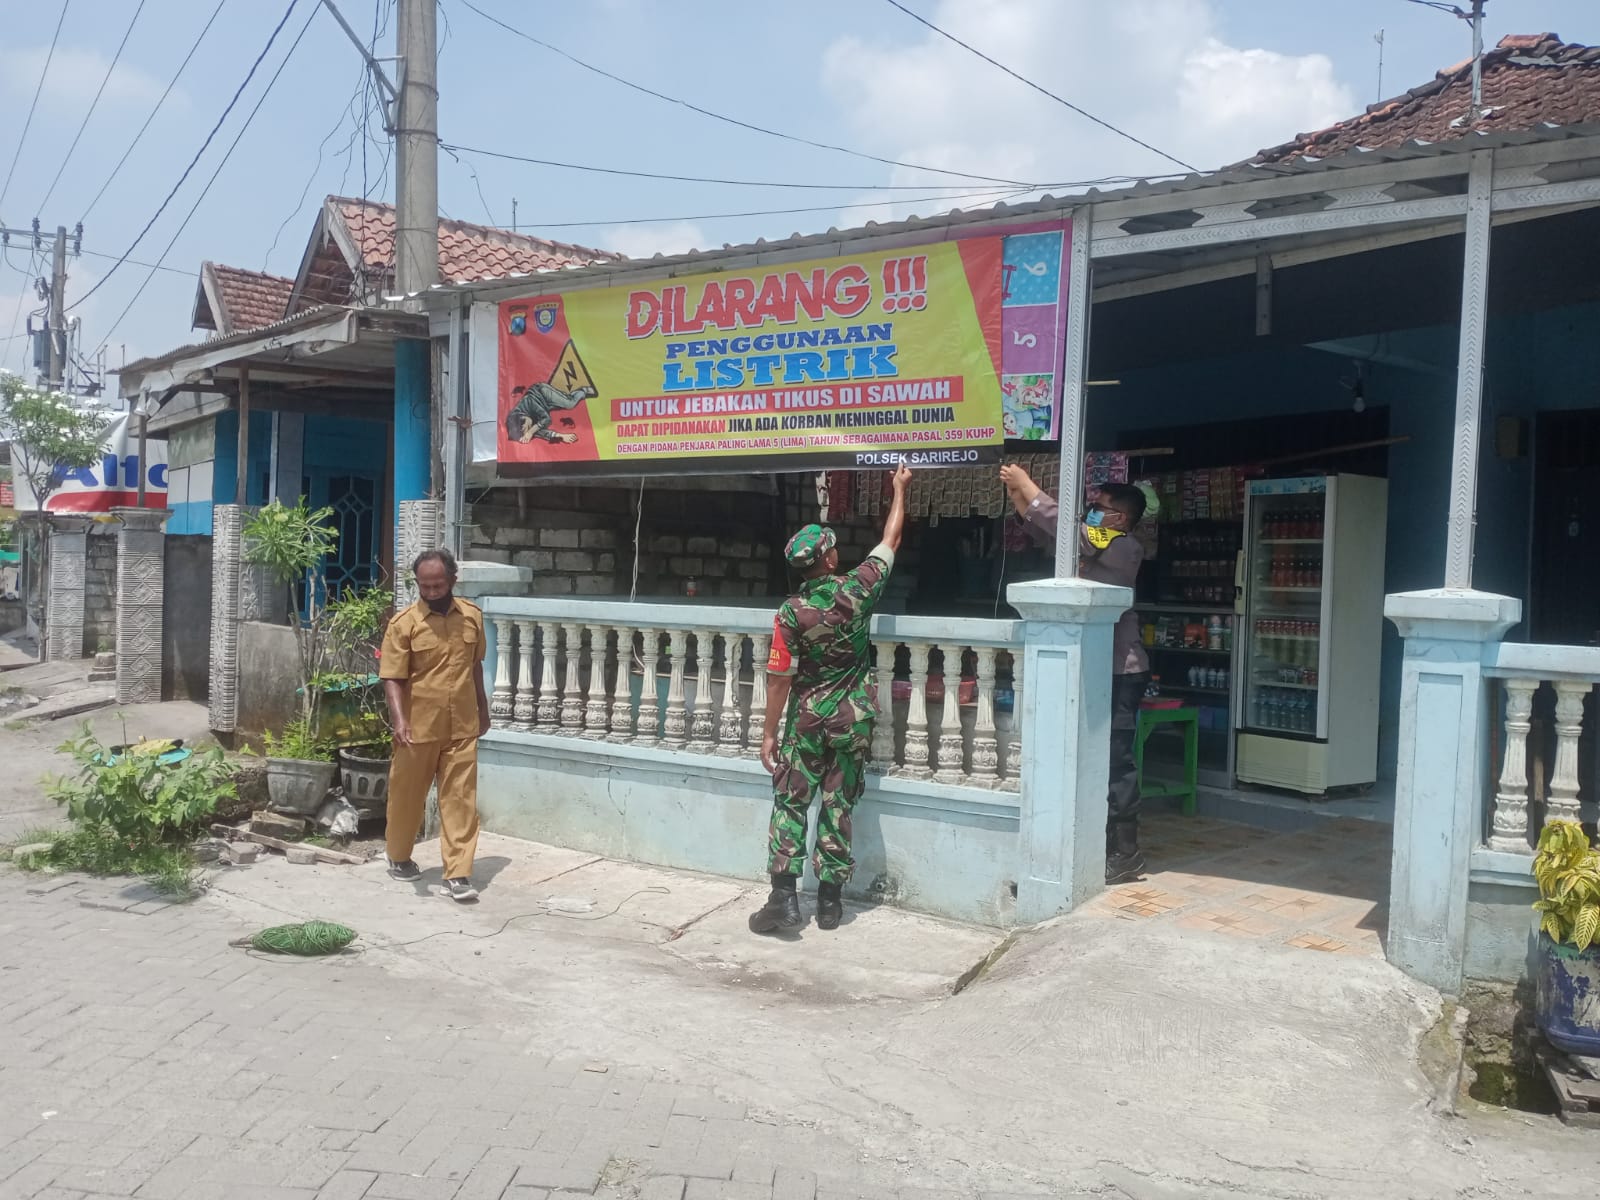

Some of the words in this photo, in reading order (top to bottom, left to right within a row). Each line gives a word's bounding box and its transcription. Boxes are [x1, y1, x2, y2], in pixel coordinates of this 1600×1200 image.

[626, 264, 871, 338] DILARANG
[666, 323, 893, 359] PENGGUNAAN
[1014, 331, 1037, 348] 5
[662, 344, 898, 391] LISTRIK
[620, 398, 679, 417] UNTUK
[684, 392, 767, 413] JEBAKAN
[772, 387, 834, 409] TIKUS
[839, 386, 862, 405] DI
[867, 380, 950, 404] SAWAH
[617, 422, 649, 437] DAPAT
[652, 420, 725, 436] DIPIDANAKAN
[728, 417, 753, 432] JIKA
[755, 416, 778, 431] ADA
[781, 413, 832, 430] KORBAN
[835, 409, 908, 428] MENINGGAL
[912, 406, 955, 423] DUNIA
[617, 443, 648, 453] DENGAN
[650, 442, 678, 452] PIDANA
[680, 440, 715, 451] PENJARA
[717, 439, 746, 450] PALING
[748, 438, 772, 448] LAMA
[773, 437, 779, 447] 5
[780, 436, 807, 448] (LIMA)
[809, 435, 840, 446] TAHUN
[842, 432, 910, 445] SEBAGAIMANA
[912, 430, 942, 441] PASAL
[945, 430, 963, 441] 359
[966, 427, 995, 440] KUHP
[856, 452, 907, 465] POLSEK
[911, 450, 978, 464] SARIREJO
